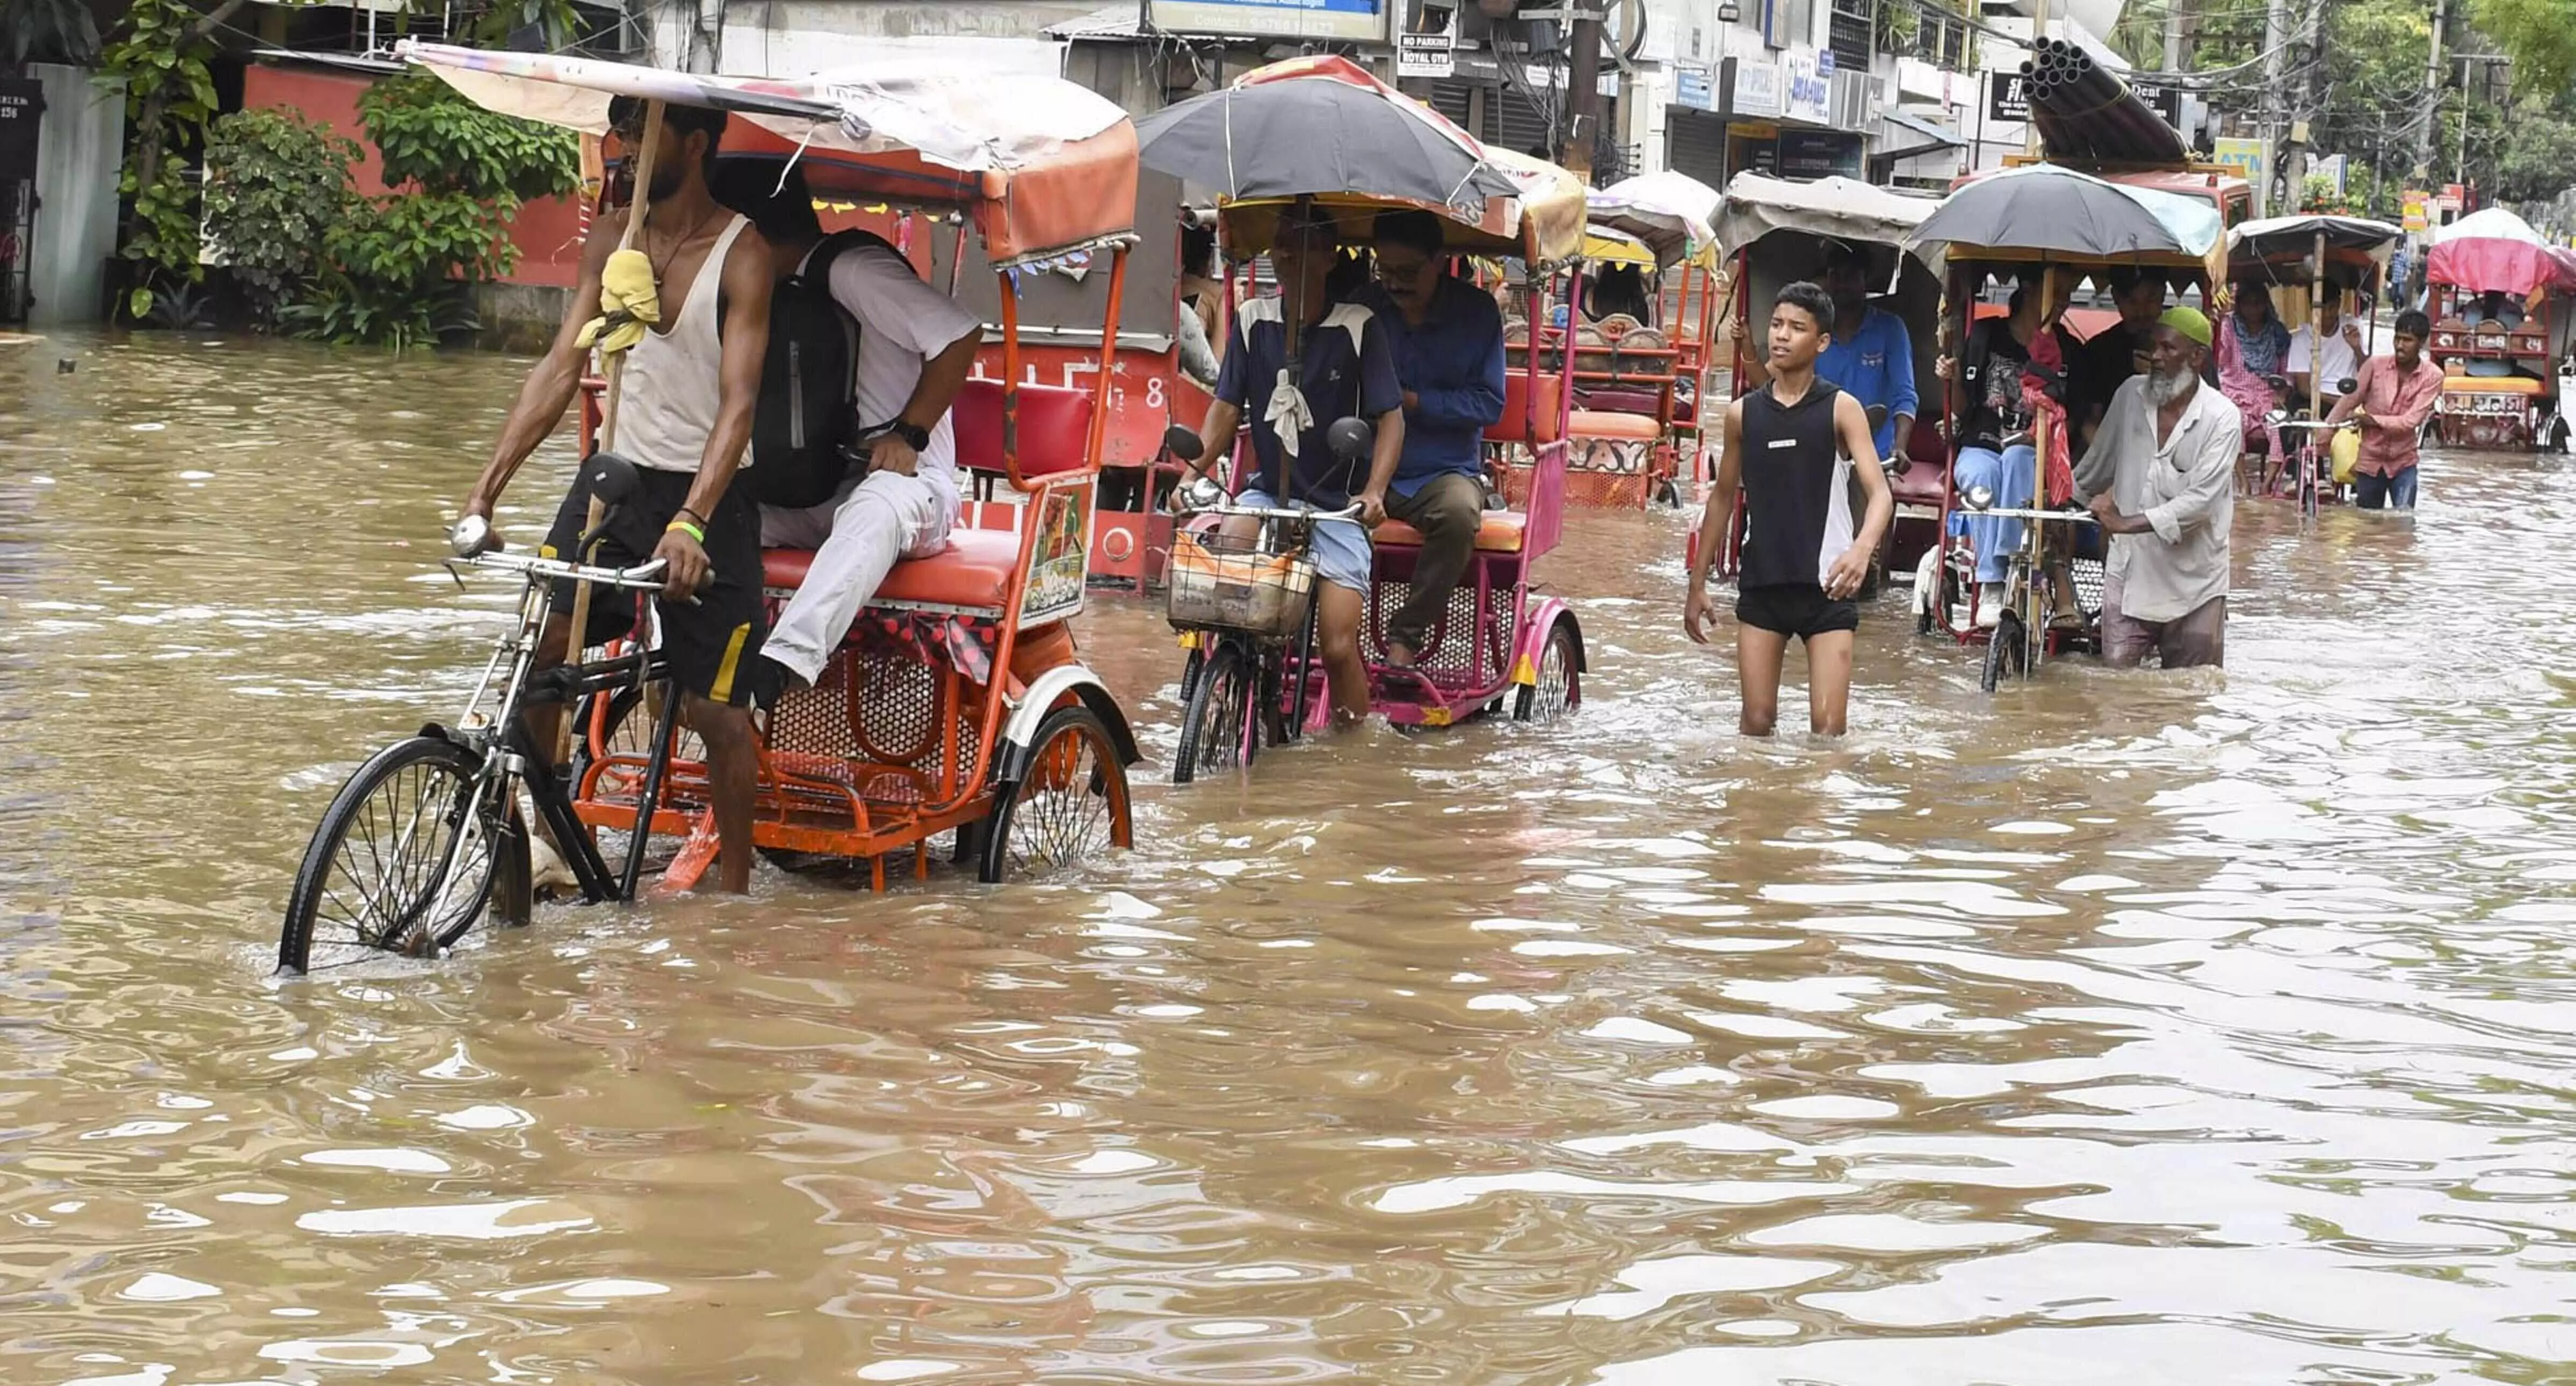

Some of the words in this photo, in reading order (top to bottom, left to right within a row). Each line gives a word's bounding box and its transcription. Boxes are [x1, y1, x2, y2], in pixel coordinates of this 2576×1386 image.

[1403, 37, 1415, 46] NO
[1416, 37, 1449, 47] PARKING
[1402, 53, 1430, 63] ROYAL
[1431, 53, 1448, 63] GYM
[1146, 378, 1164, 408] 8
